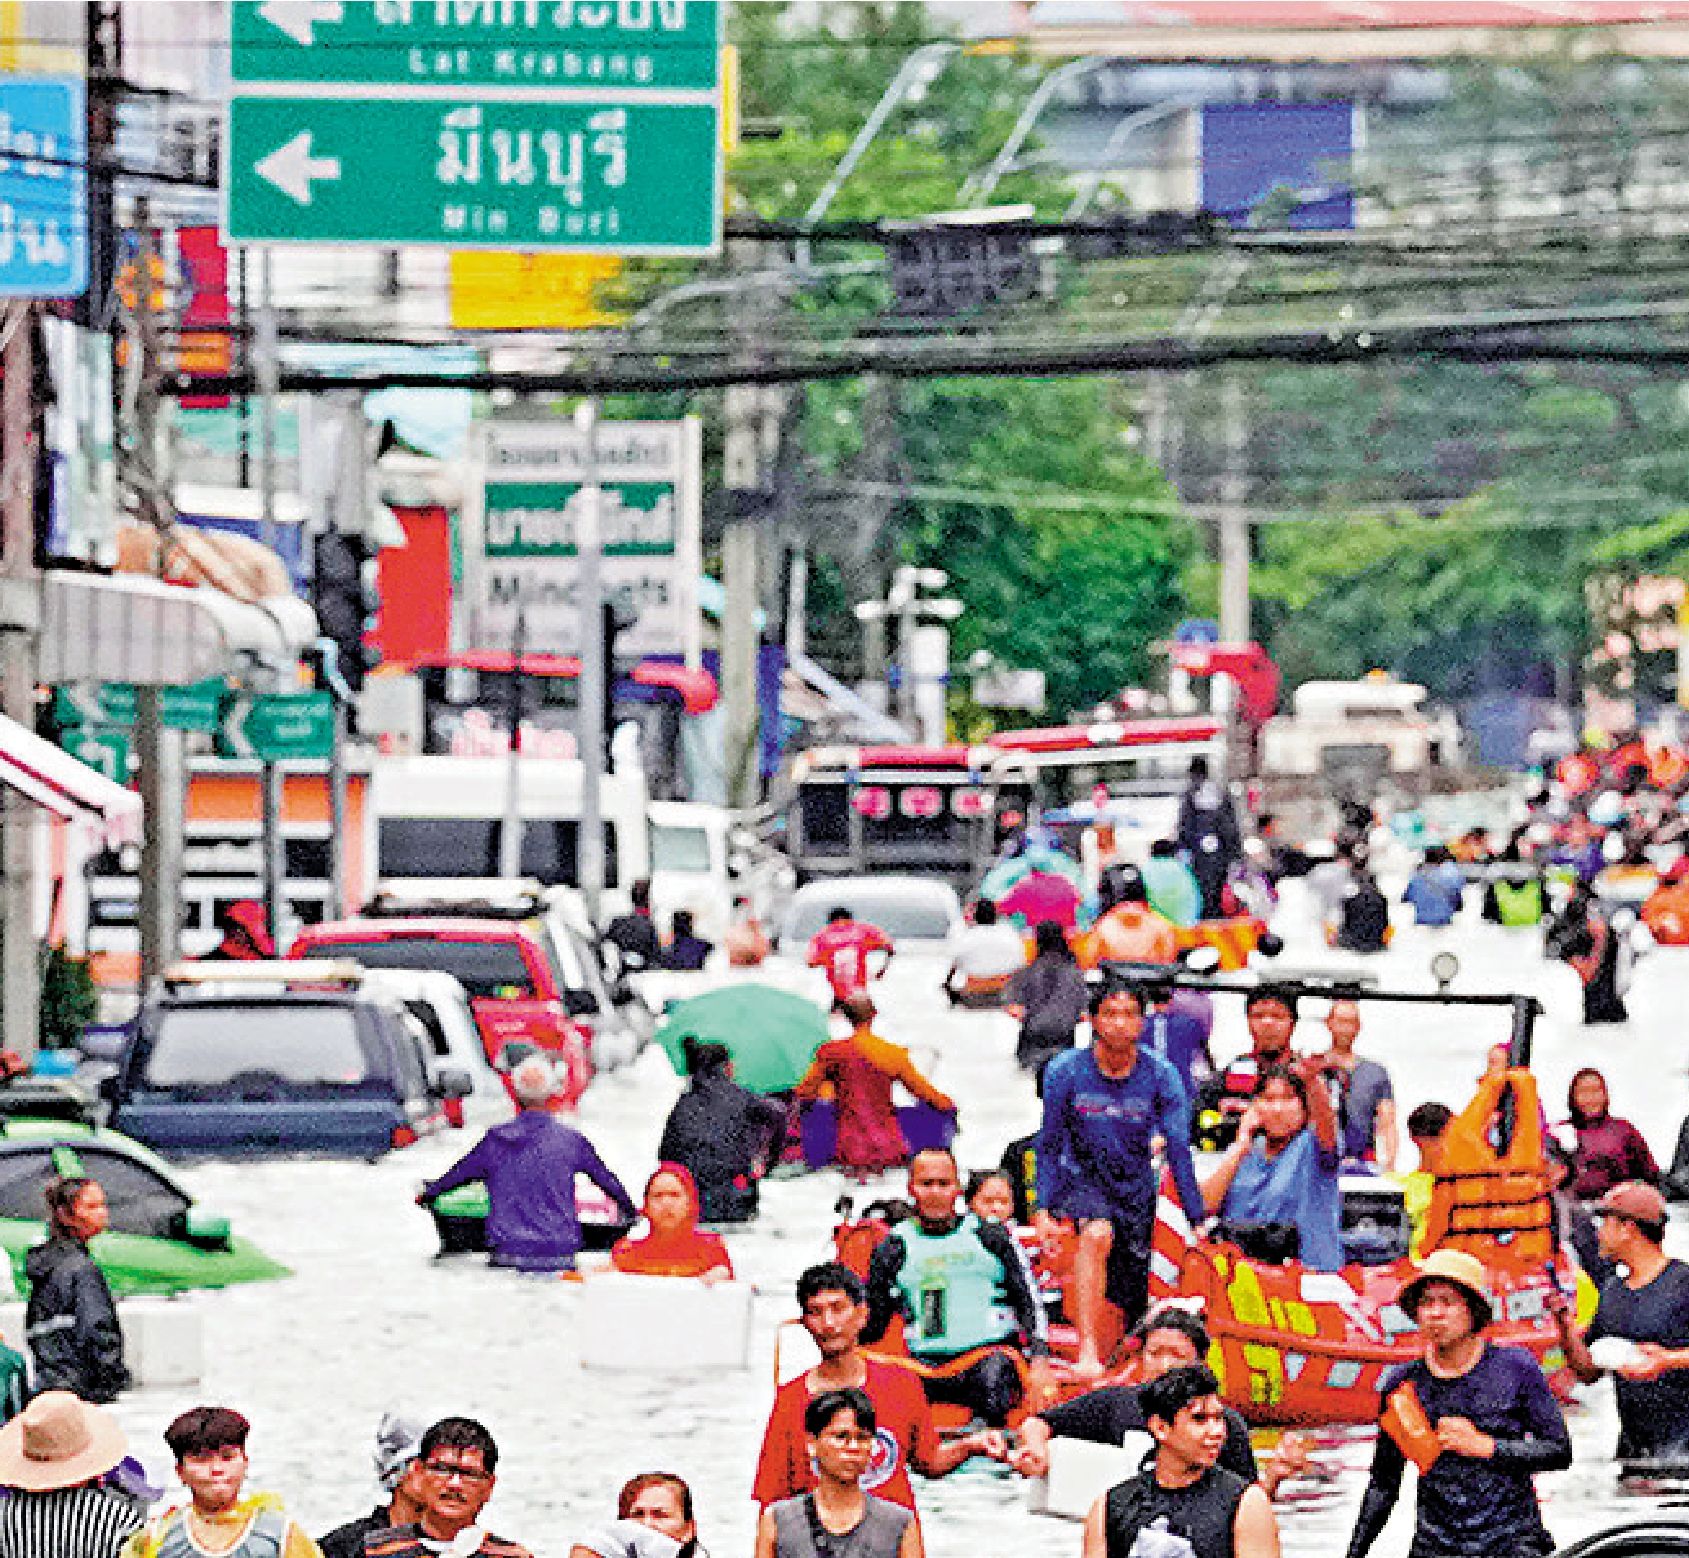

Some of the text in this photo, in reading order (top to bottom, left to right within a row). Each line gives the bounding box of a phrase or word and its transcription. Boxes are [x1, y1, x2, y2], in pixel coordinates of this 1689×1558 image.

[409, 49, 654, 82] Lat Krabang
[436, 107, 628, 206] มีนบุรี
[442, 203, 619, 235] Min Buri
